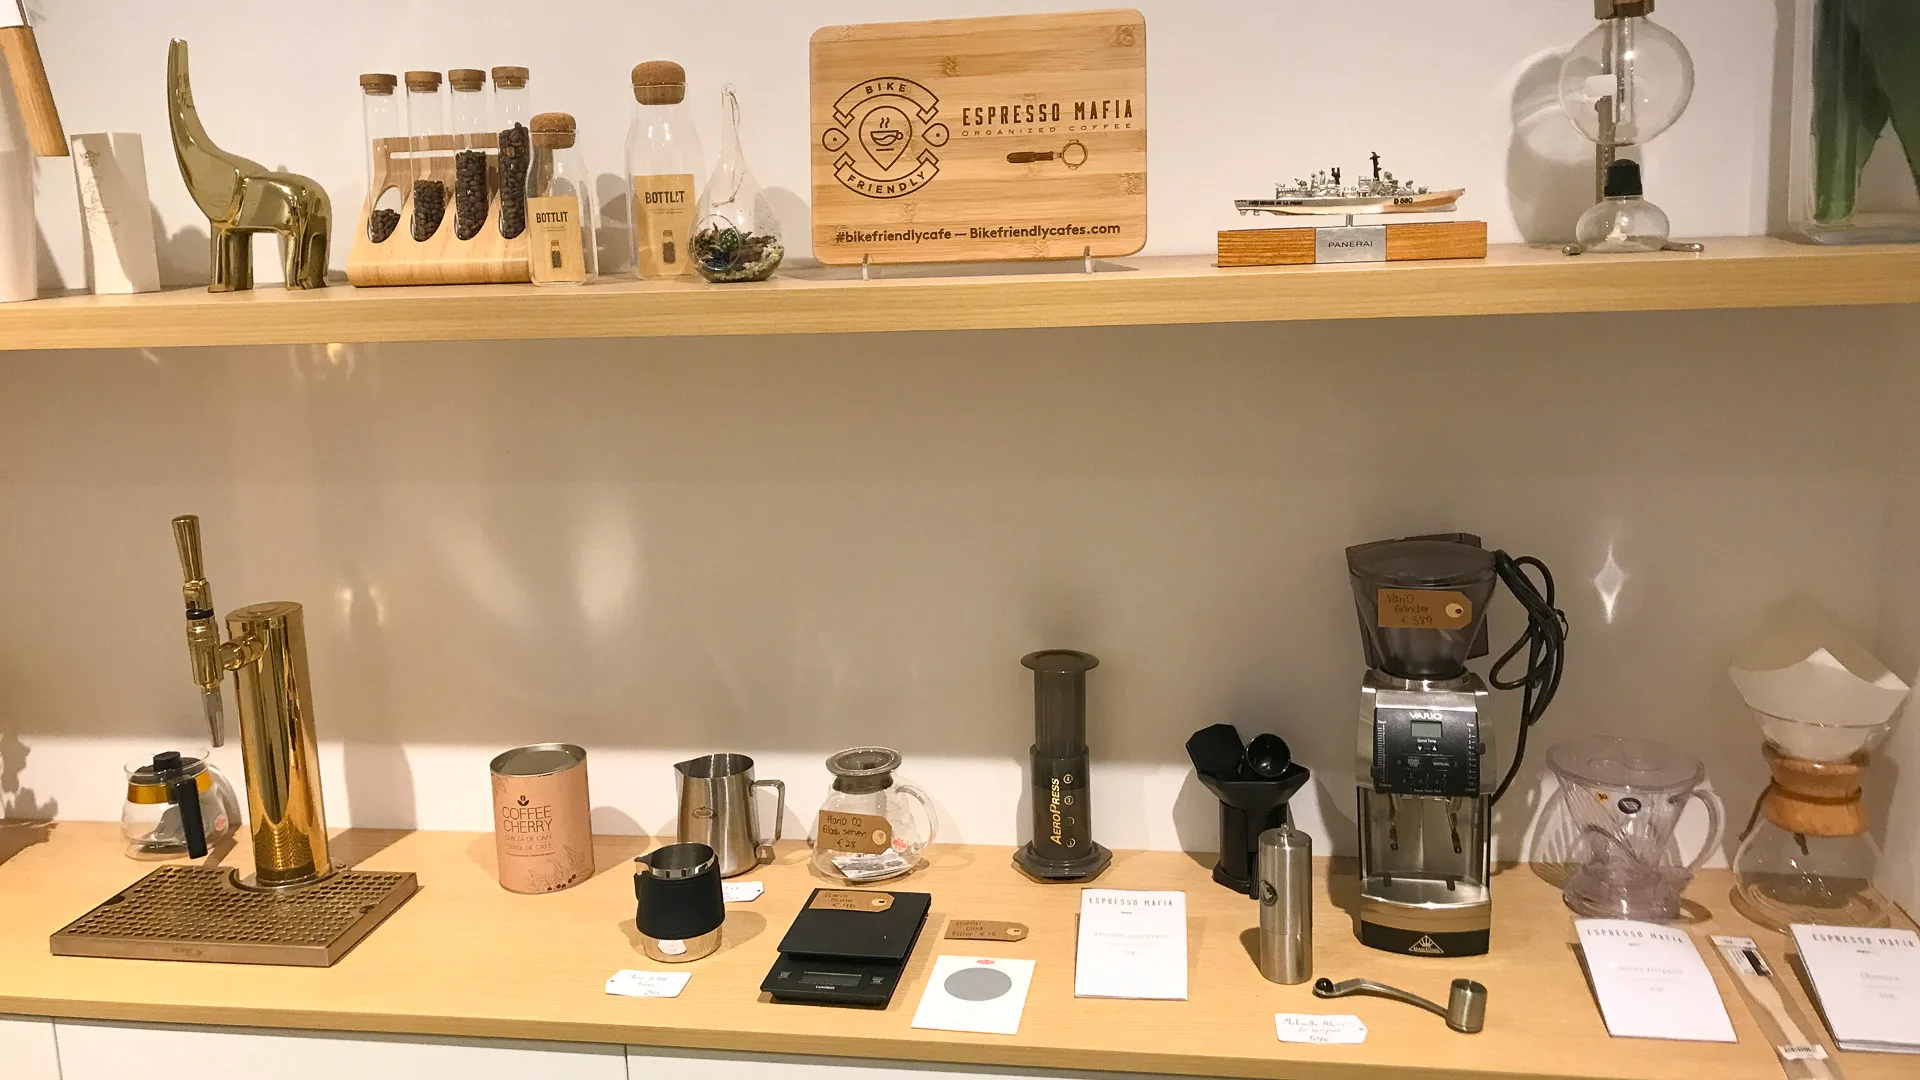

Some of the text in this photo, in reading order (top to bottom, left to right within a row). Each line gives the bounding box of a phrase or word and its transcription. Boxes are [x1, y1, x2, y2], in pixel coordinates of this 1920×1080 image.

[865, 81, 907, 95] BIKE
[962, 99, 1133, 127] ESPRESSO MAFIA
[962, 123, 1132, 137] ORGANIZED COFFEE
[847, 170, 926, 195] FRIENDLY
[644, 190, 685, 204] BOTTLIT
[535, 211, 568, 224] BOTTLIT
[834, 227, 952, 245] #bikefriendlycafe
[969, 222, 1121, 240] Bikefriendlycafes.com
[1328, 240, 1373, 249] PANERAI
[1409, 711, 1443, 720] VARIO
[501, 804, 552, 820] COFFEE
[503, 818, 553, 834] CHERRY
[1089, 897, 1138, 907] ESPRESSO
[1812, 933, 1872, 945] ESPRESSO
